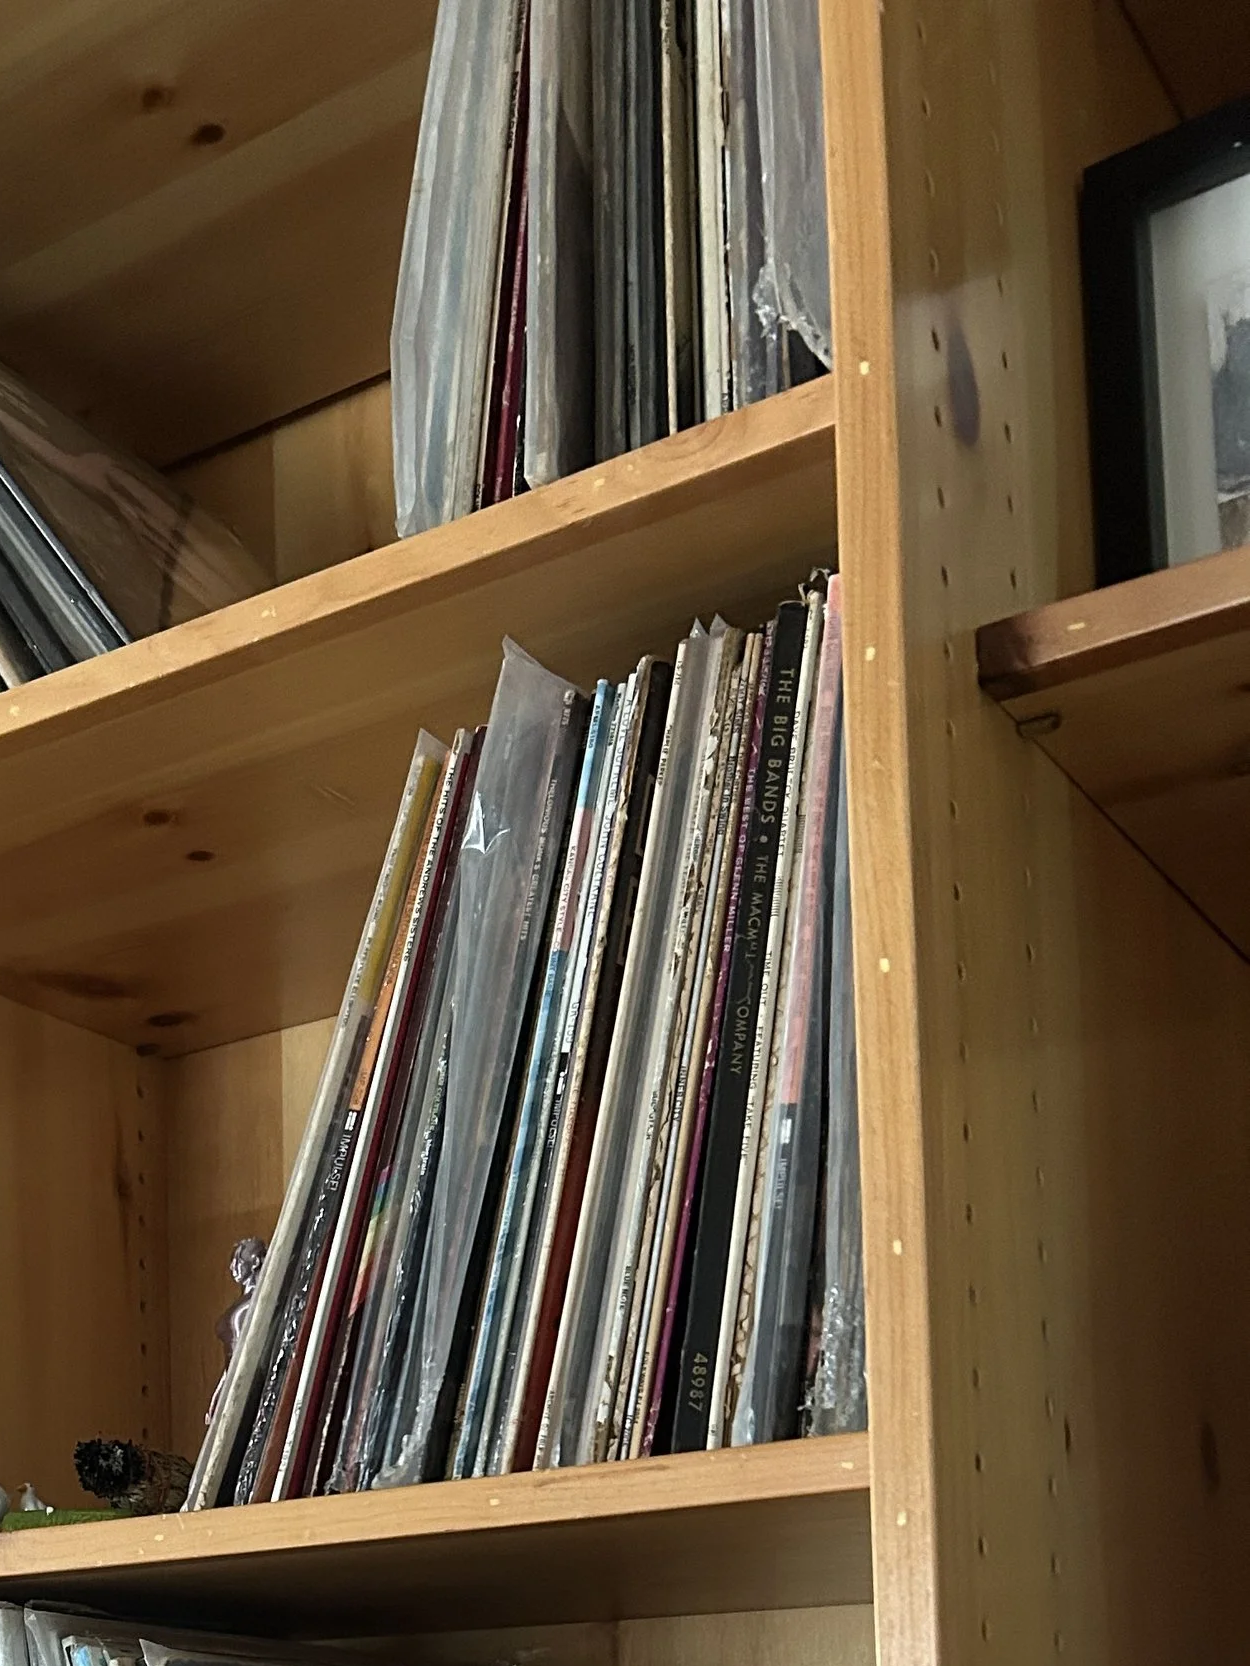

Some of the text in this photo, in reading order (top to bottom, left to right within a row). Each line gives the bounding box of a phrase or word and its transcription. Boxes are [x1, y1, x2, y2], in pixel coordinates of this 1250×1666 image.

[776, 668, 794, 703] THE
[618, 711, 630, 741] LOVE
[770, 714, 787, 747] BIG
[759, 757, 782, 824] BANDS
[597, 814, 612, 848] JOHN
[776, 805, 790, 857] QUARTET
[402, 766, 455, 961] THE HITS OF THE ANDREWS SISTERS
[722, 767, 756, 948] THE BEST OF GLENN MILLER
[753, 855, 770, 885] THE
[561, 883, 570, 901] CITY
[585, 853, 606, 916] COLTRANE
[519, 919, 530, 939] HITS
[556, 904, 566, 931] STYLE
[762, 950, 773, 975] TIME
[759, 982, 769, 1006] OUT
[727, 994, 751, 1075] OMPANY
[748, 1025, 765, 1089] FEATURING
[743, 1101, 755, 1125] TAKE
[327, 1133, 352, 1191] IMPULSE!
[687, 1352, 709, 1412] 48987
